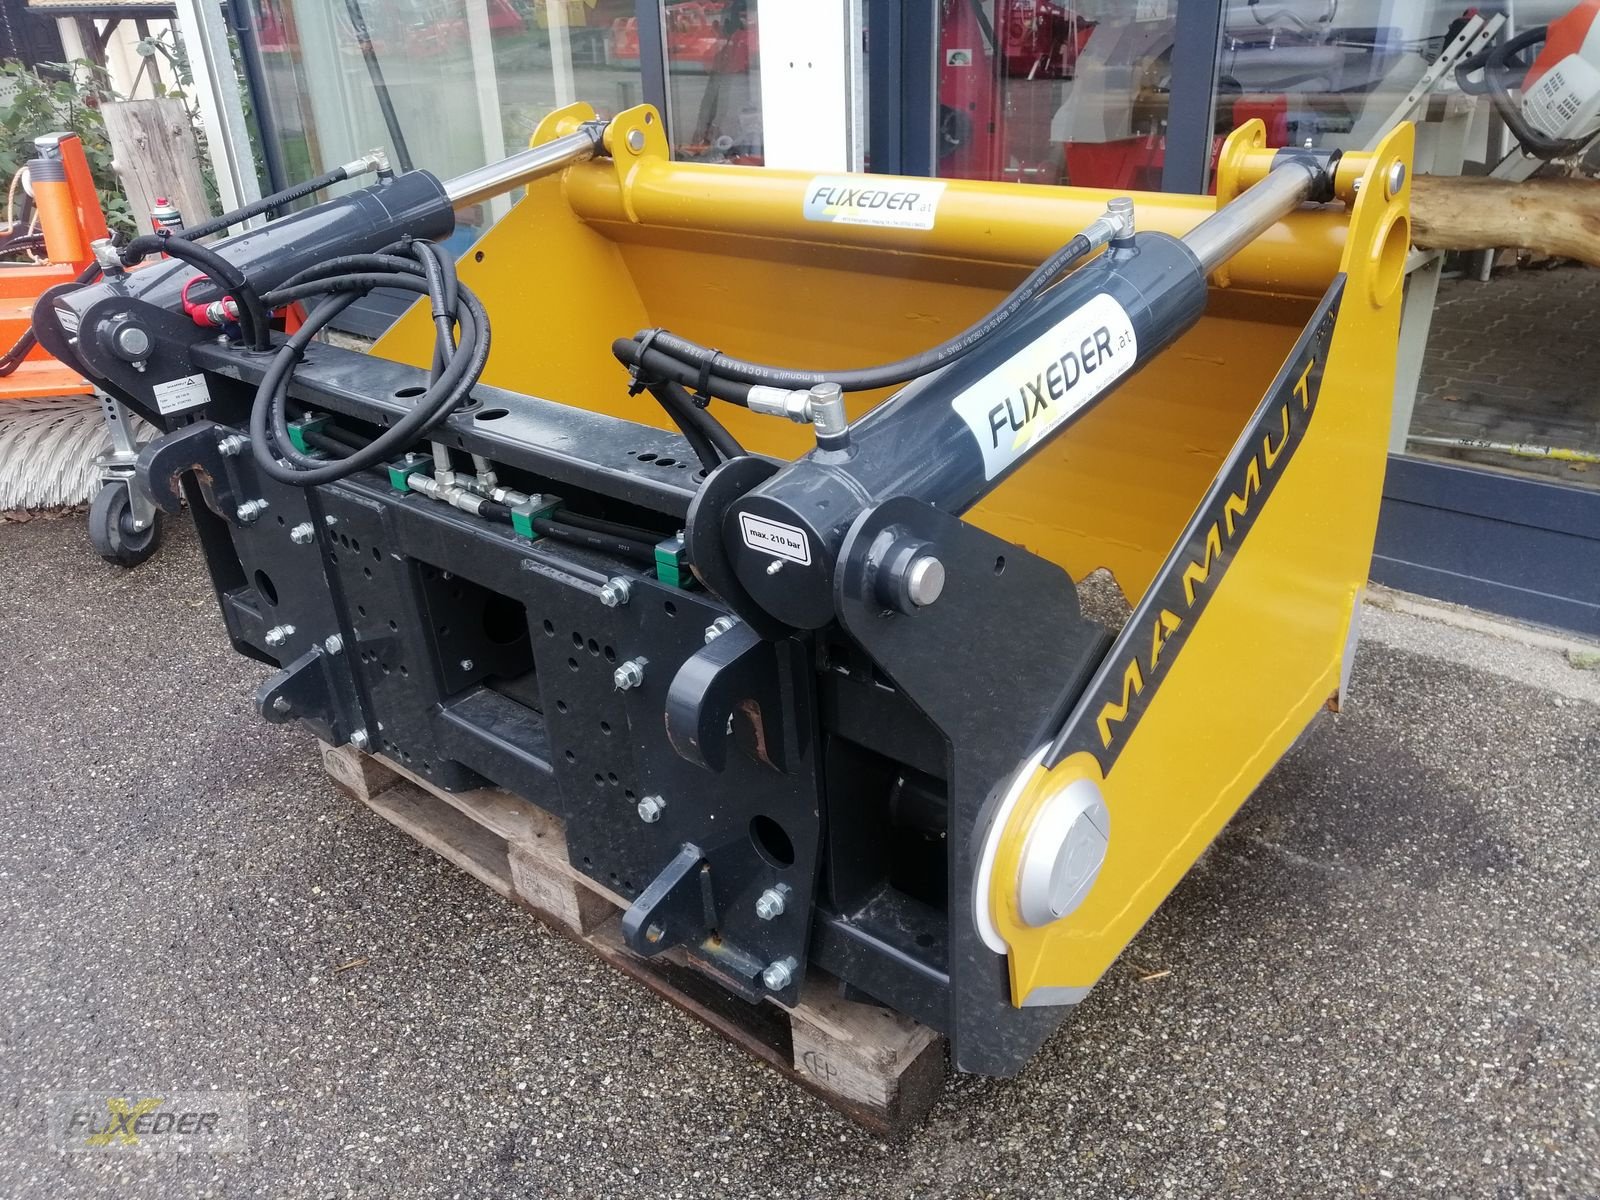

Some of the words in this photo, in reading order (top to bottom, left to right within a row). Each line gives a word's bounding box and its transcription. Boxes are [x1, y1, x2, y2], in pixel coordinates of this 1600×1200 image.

[811, 187, 920, 211] FLIXEDER
[987, 326, 1114, 450] FLIXEDER
[749, 529, 769, 540] max.
[770, 534, 786, 545] 210
[787, 538, 801, 550] bar
[1095, 358, 1317, 751] MAMMUT
